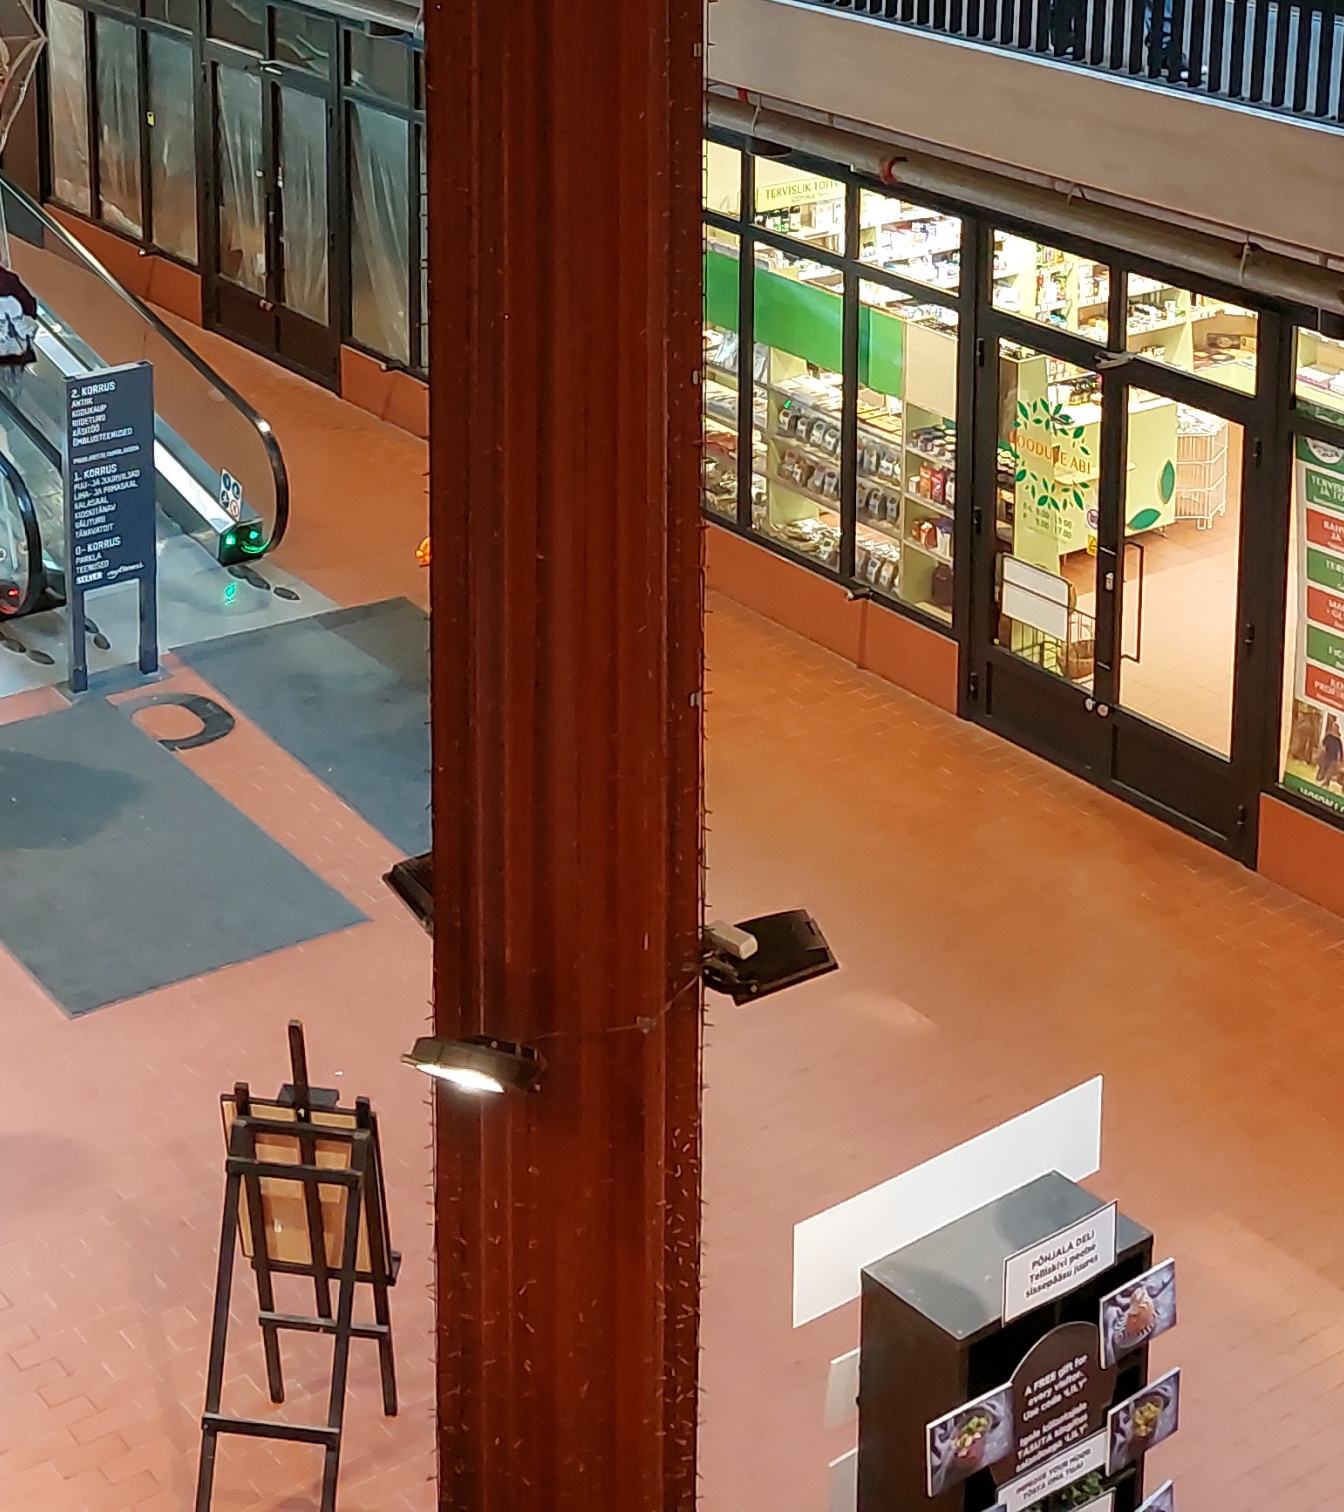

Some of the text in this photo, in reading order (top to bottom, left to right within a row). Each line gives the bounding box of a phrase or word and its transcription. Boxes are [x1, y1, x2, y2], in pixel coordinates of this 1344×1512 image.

[765, 182, 812, 200] TERVISLIK
[71, 381, 116, 398] 2. KORRUS
[83, 464, 117, 479] KORRUS
[1070, 456, 1091, 476] ABI
[87, 536, 121, 552] KORRUS
[76, 572, 103, 584] SELVER
[1031, 1230, 1095, 1270] PÕHJALA DELI
[1029, 1257, 1067, 1284] Telliskivi
[1017, 1433, 1053, 1460] TASUTA
